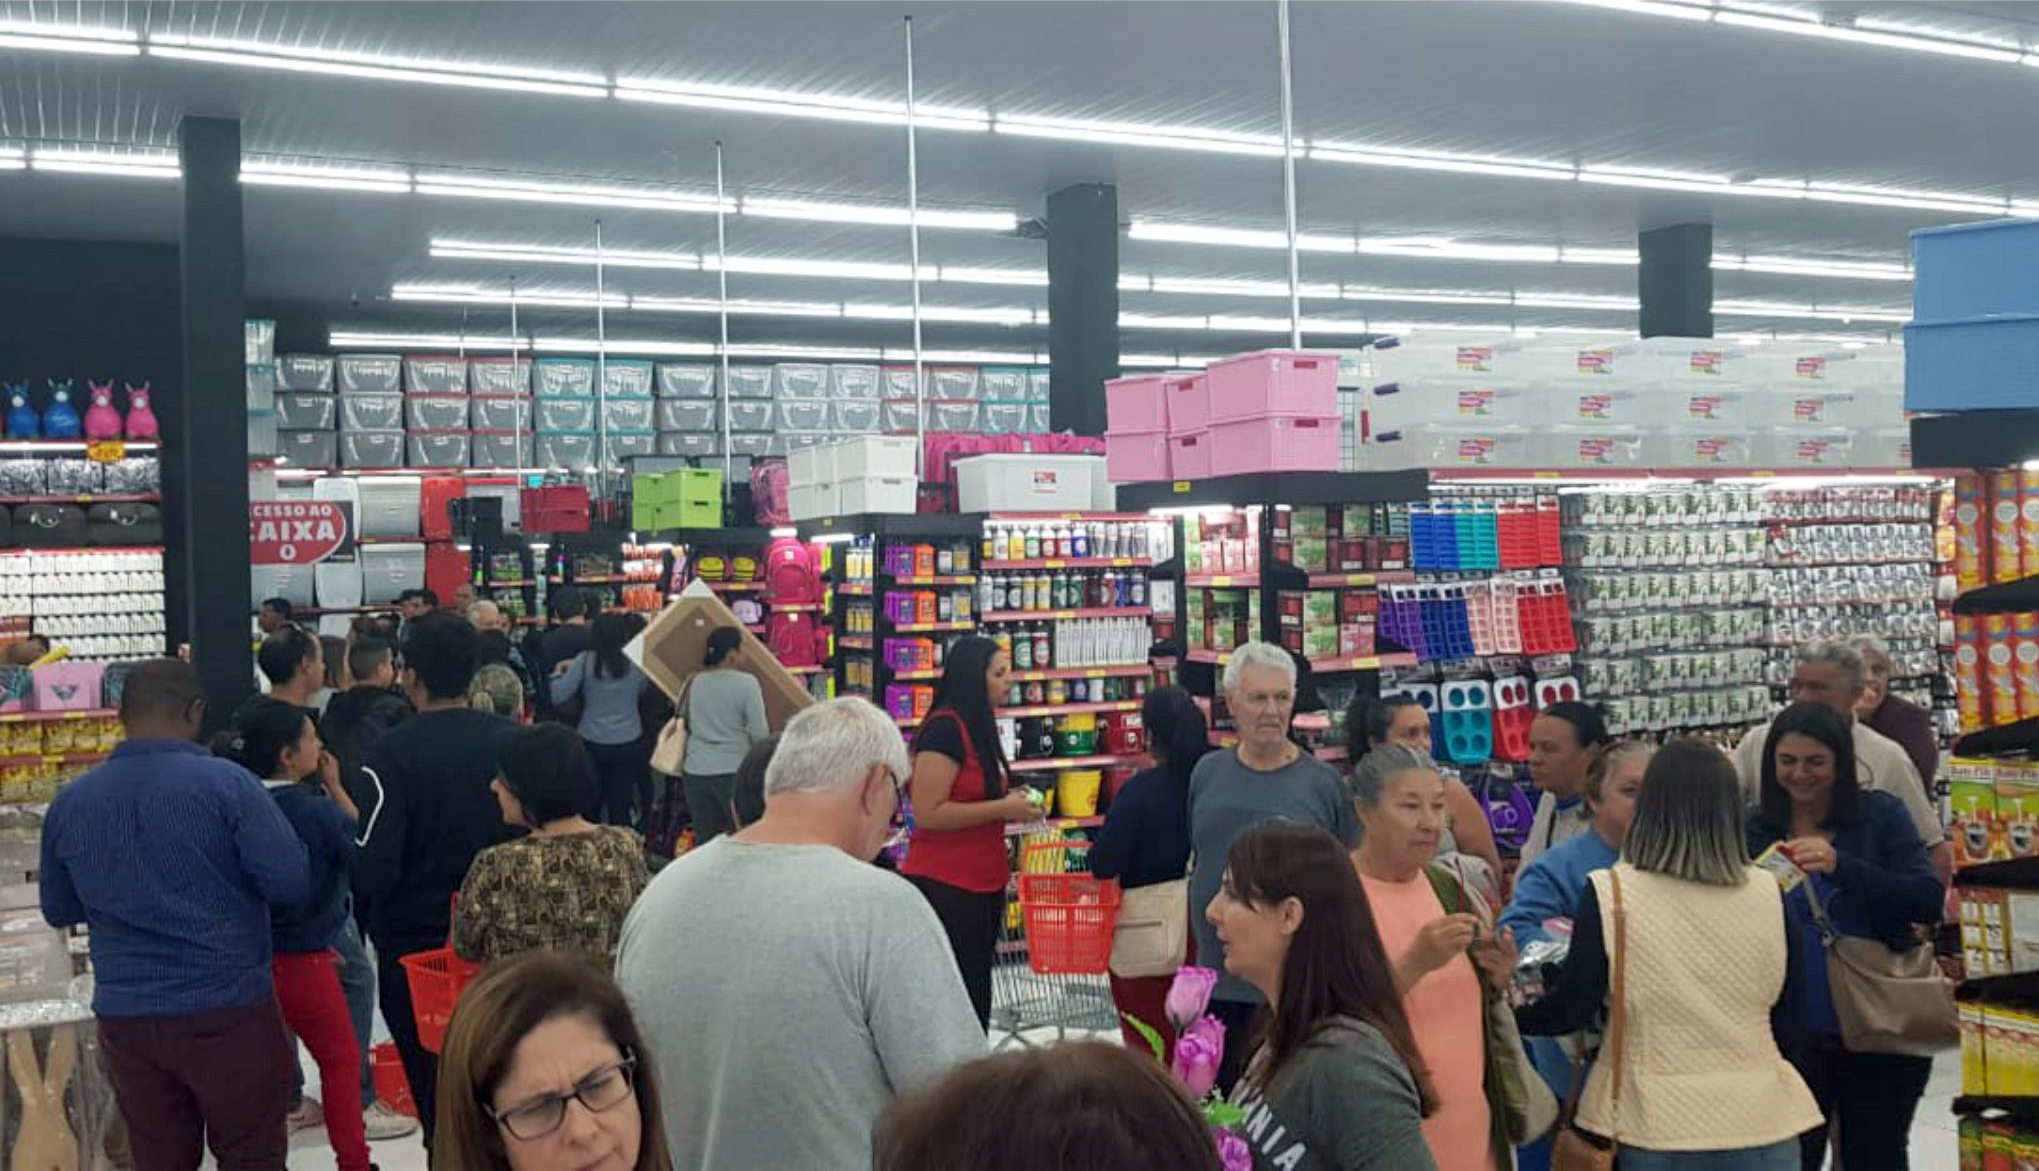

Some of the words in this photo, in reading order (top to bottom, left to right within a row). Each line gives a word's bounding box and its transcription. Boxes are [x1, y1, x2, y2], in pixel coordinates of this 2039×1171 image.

[251, 504, 306, 517] CESSO
[309, 504, 332, 516] AO
[250, 520, 336, 542] AIXA
